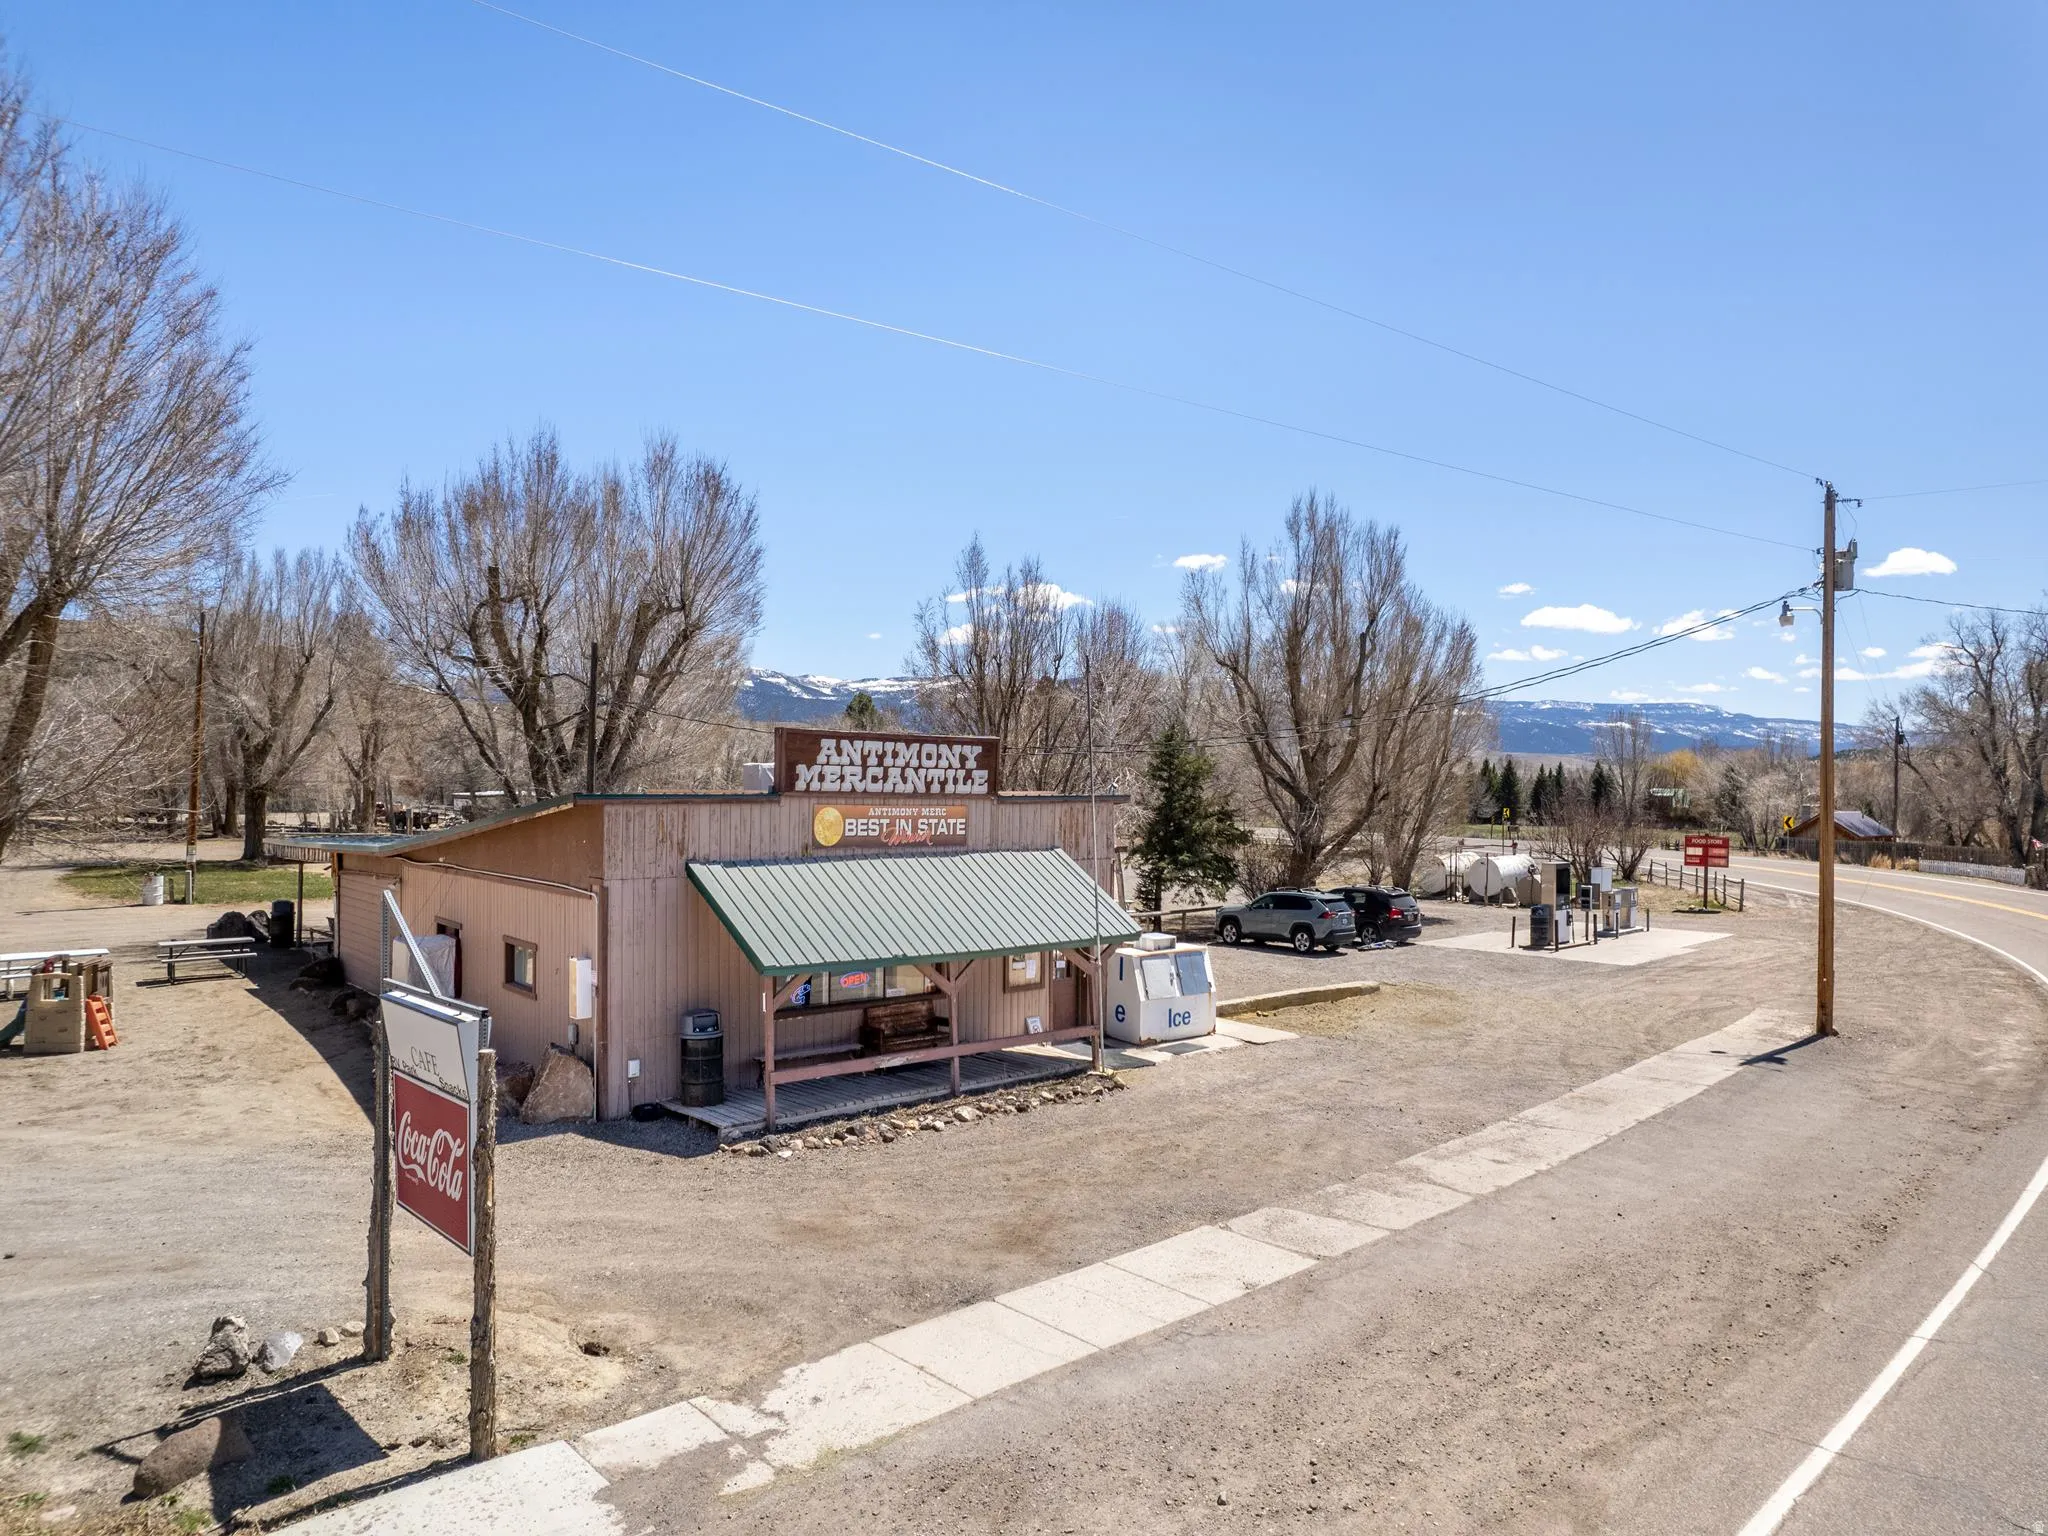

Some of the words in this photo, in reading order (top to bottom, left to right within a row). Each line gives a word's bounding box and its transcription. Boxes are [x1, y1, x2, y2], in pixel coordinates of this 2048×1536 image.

[816, 738, 982, 770] ANTIMONY
[795, 764, 989, 795] MERCANTILE
[868, 808, 919, 816] ANTIMONY
[921, 808, 947, 816] MERC
[844, 818, 890, 837] BEST
[895, 818, 912, 836] IN
[918, 818, 966, 836] STATE
[842, 973, 868, 987] OPEN
[1168, 1008, 1191, 1028] Ice
[410, 1046, 440, 1077] CAFE
[438, 1076, 468, 1099] Snacks
[398, 1110, 466, 1202] Coca-Cola
